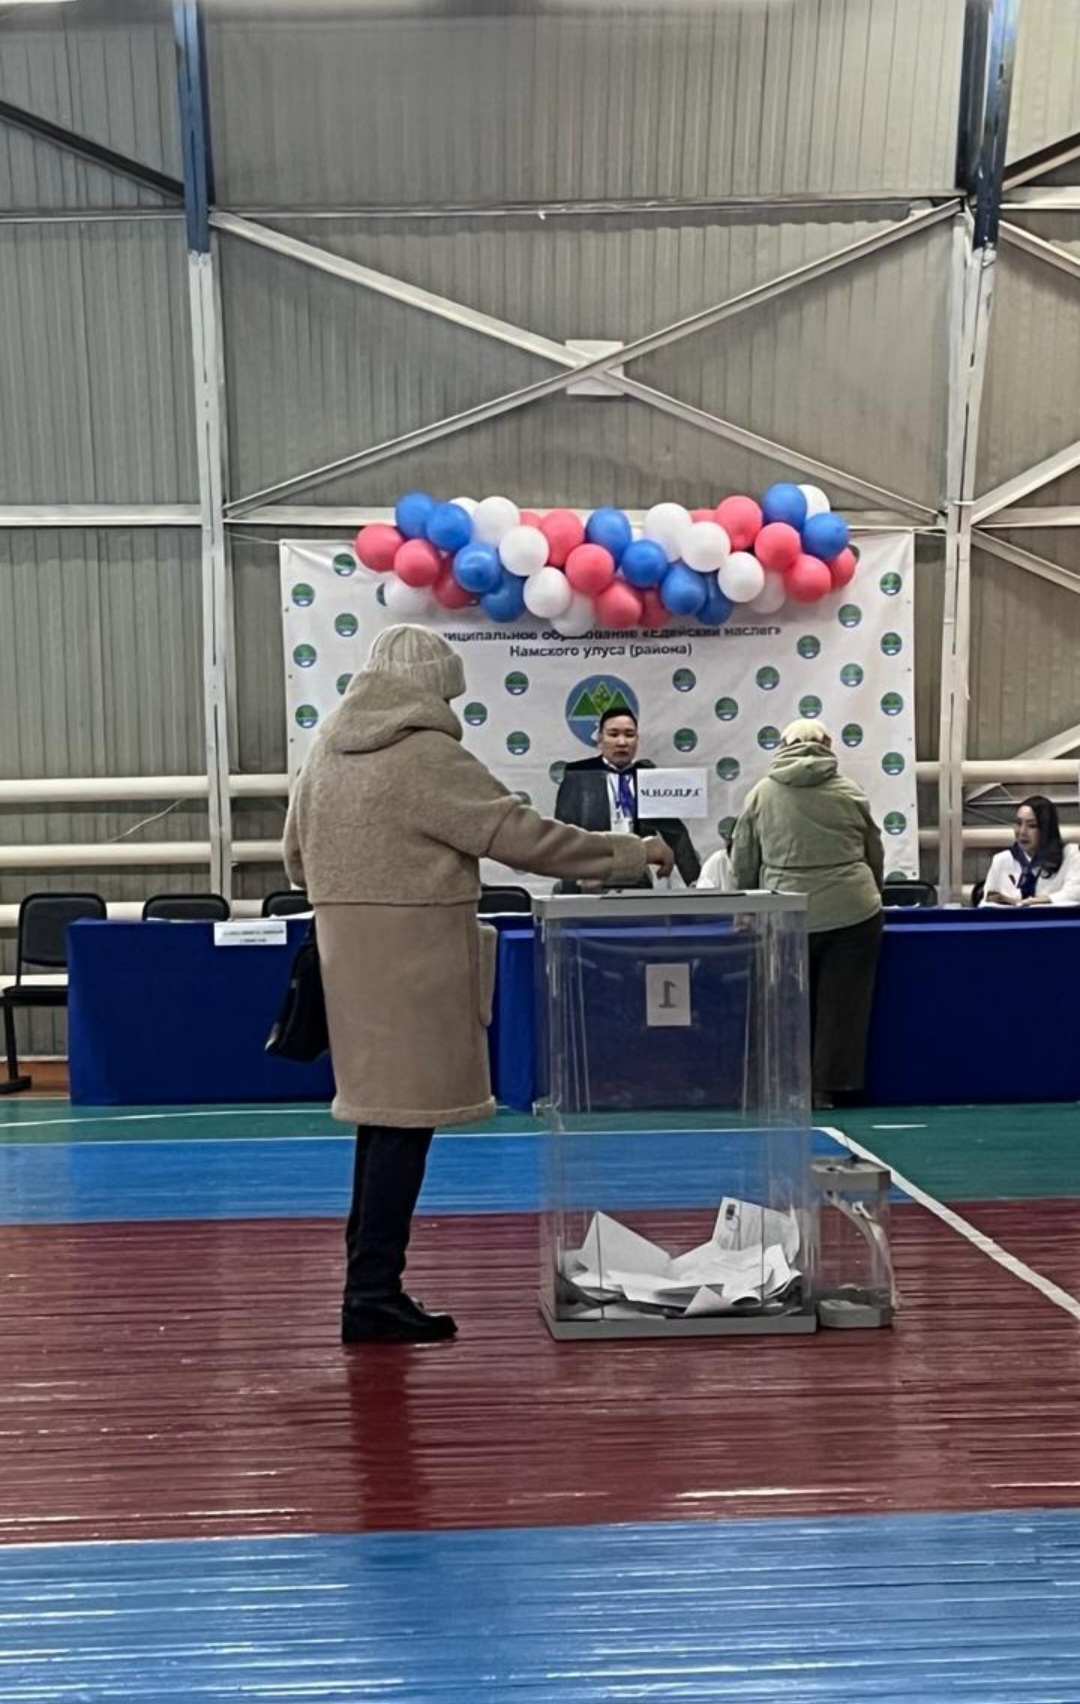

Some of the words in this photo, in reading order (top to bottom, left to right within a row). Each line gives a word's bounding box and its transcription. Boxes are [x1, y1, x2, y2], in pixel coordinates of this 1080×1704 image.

[443, 631, 538, 642] иципальное
[541, 628, 638, 642] обование
[724, 625, 781, 637] наслег»
[509, 644, 580, 657] Намского
[583, 645, 626, 659] улуса
[629, 643, 693, 658] (района)
